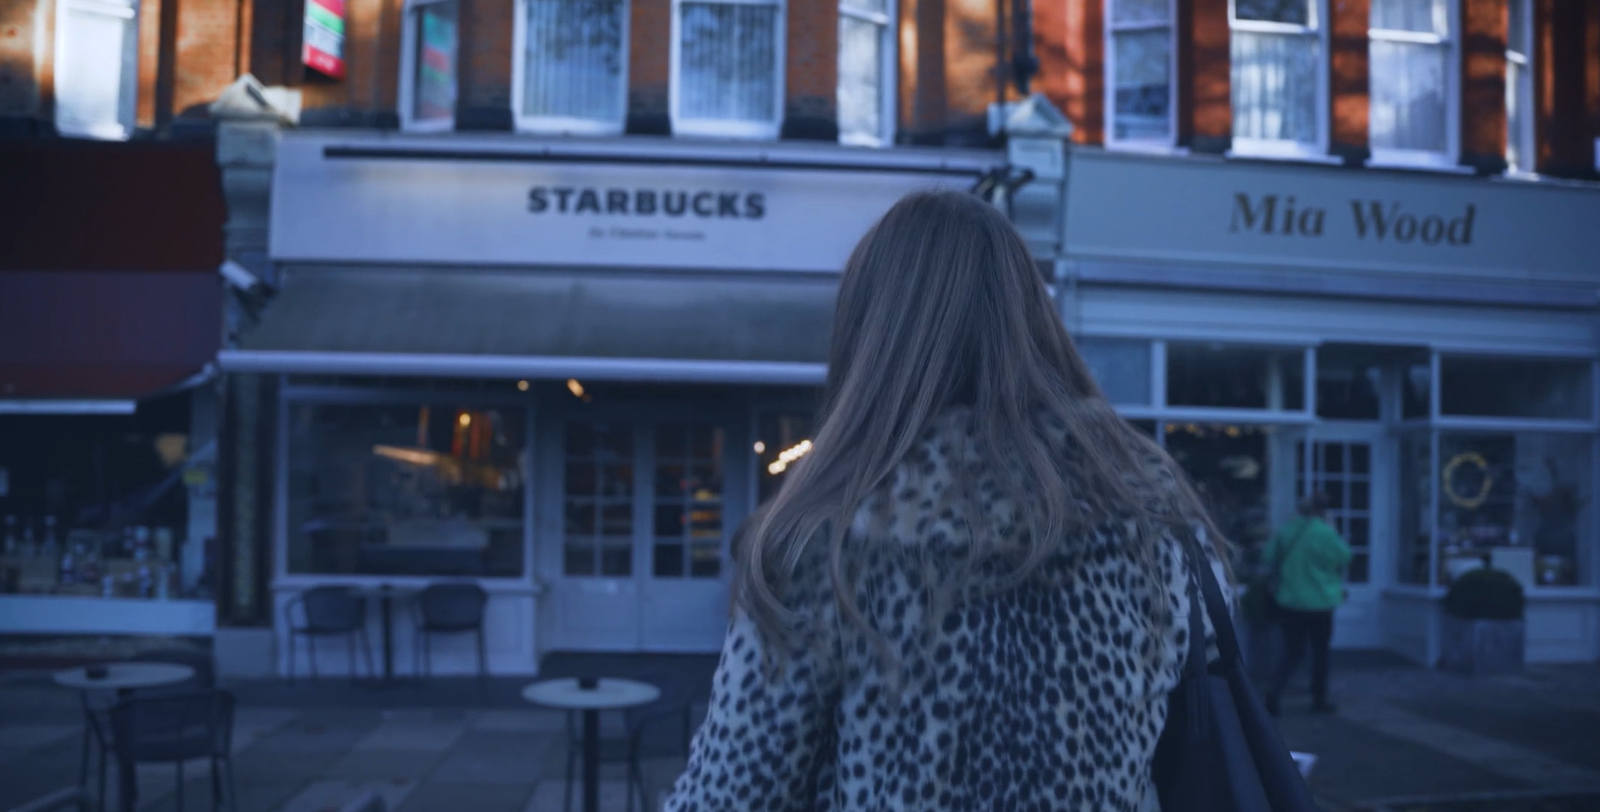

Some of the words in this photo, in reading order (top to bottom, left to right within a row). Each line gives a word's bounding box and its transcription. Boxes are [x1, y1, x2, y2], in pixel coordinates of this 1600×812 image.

[527, 186, 766, 221] STARBUCKS
[1230, 191, 1326, 237] Mia
[1350, 199, 1476, 246] Wood
